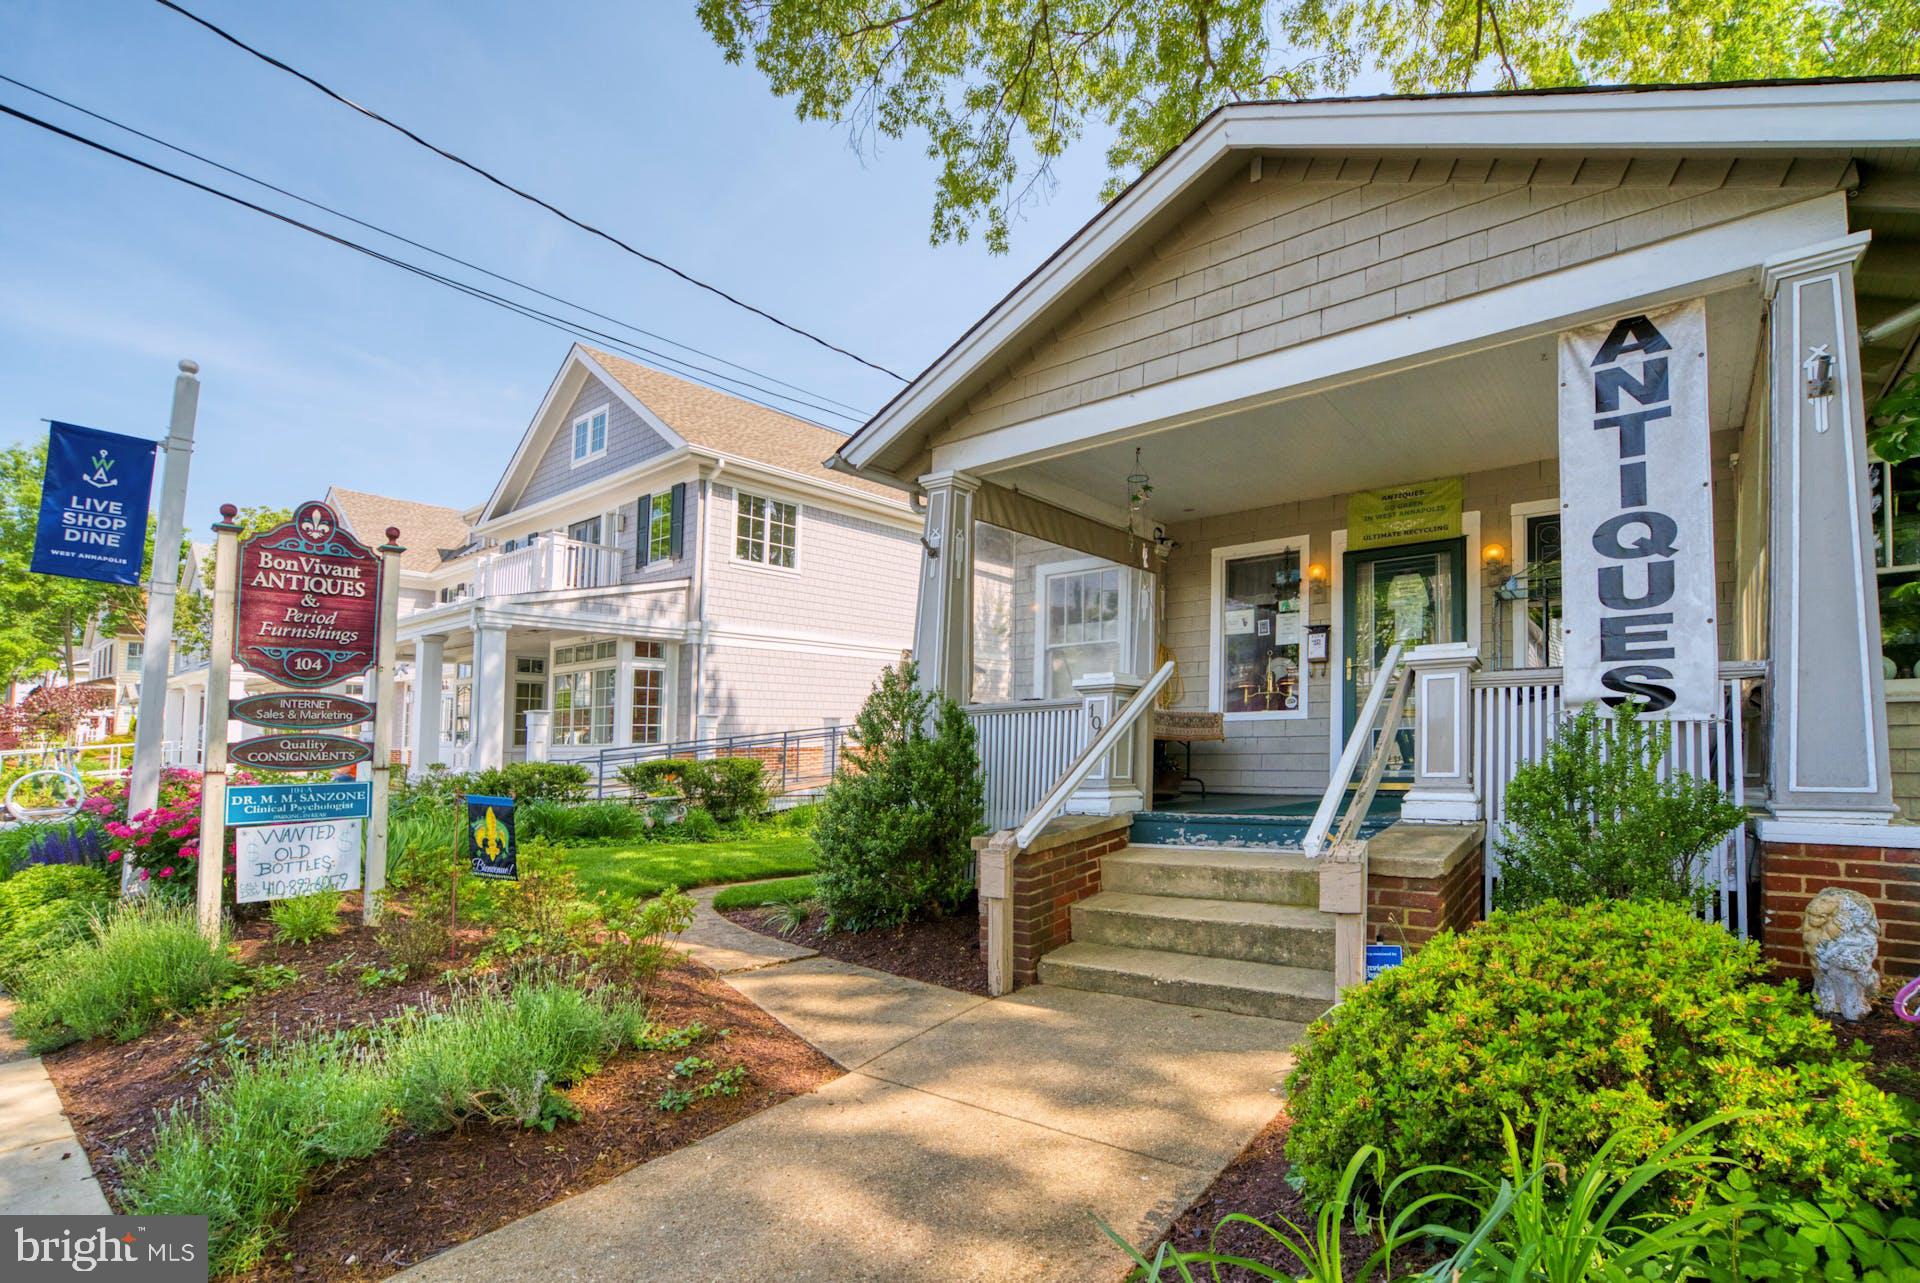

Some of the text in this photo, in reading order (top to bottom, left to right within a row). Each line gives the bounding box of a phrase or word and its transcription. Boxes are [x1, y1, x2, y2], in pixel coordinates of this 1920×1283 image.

[71, 495, 123, 515] LIVE
[1397, 501, 1424, 509] GREEN
[1589, 314, 1680, 712] ANTIQUES
[62, 511, 127, 531] SHOP
[1375, 512, 1397, 520] WEST
[64, 528, 121, 548] DINE
[1363, 524, 1449, 541] ULTIMATE RECYCLING
[50, 548, 128, 565] WEST ANNAPOLIS
[250, 571, 366, 598] ANTIQUES
[300, 593, 320, 608] &
[283, 607, 338, 625] Period
[258, 621, 359, 645] Furnishings
[294, 657, 322, 671] 104
[280, 699, 332, 709] INTERNET
[256, 709, 353, 722] Sales & Marketing
[280, 740, 328, 754] Quality
[247, 751, 355, 762] CONSIGNMENTS
[231, 791, 366, 806] DR. M. M. SANZONE
[244, 802, 354, 814] Clinical Psychologist
[274, 844, 311, 862] OLD
